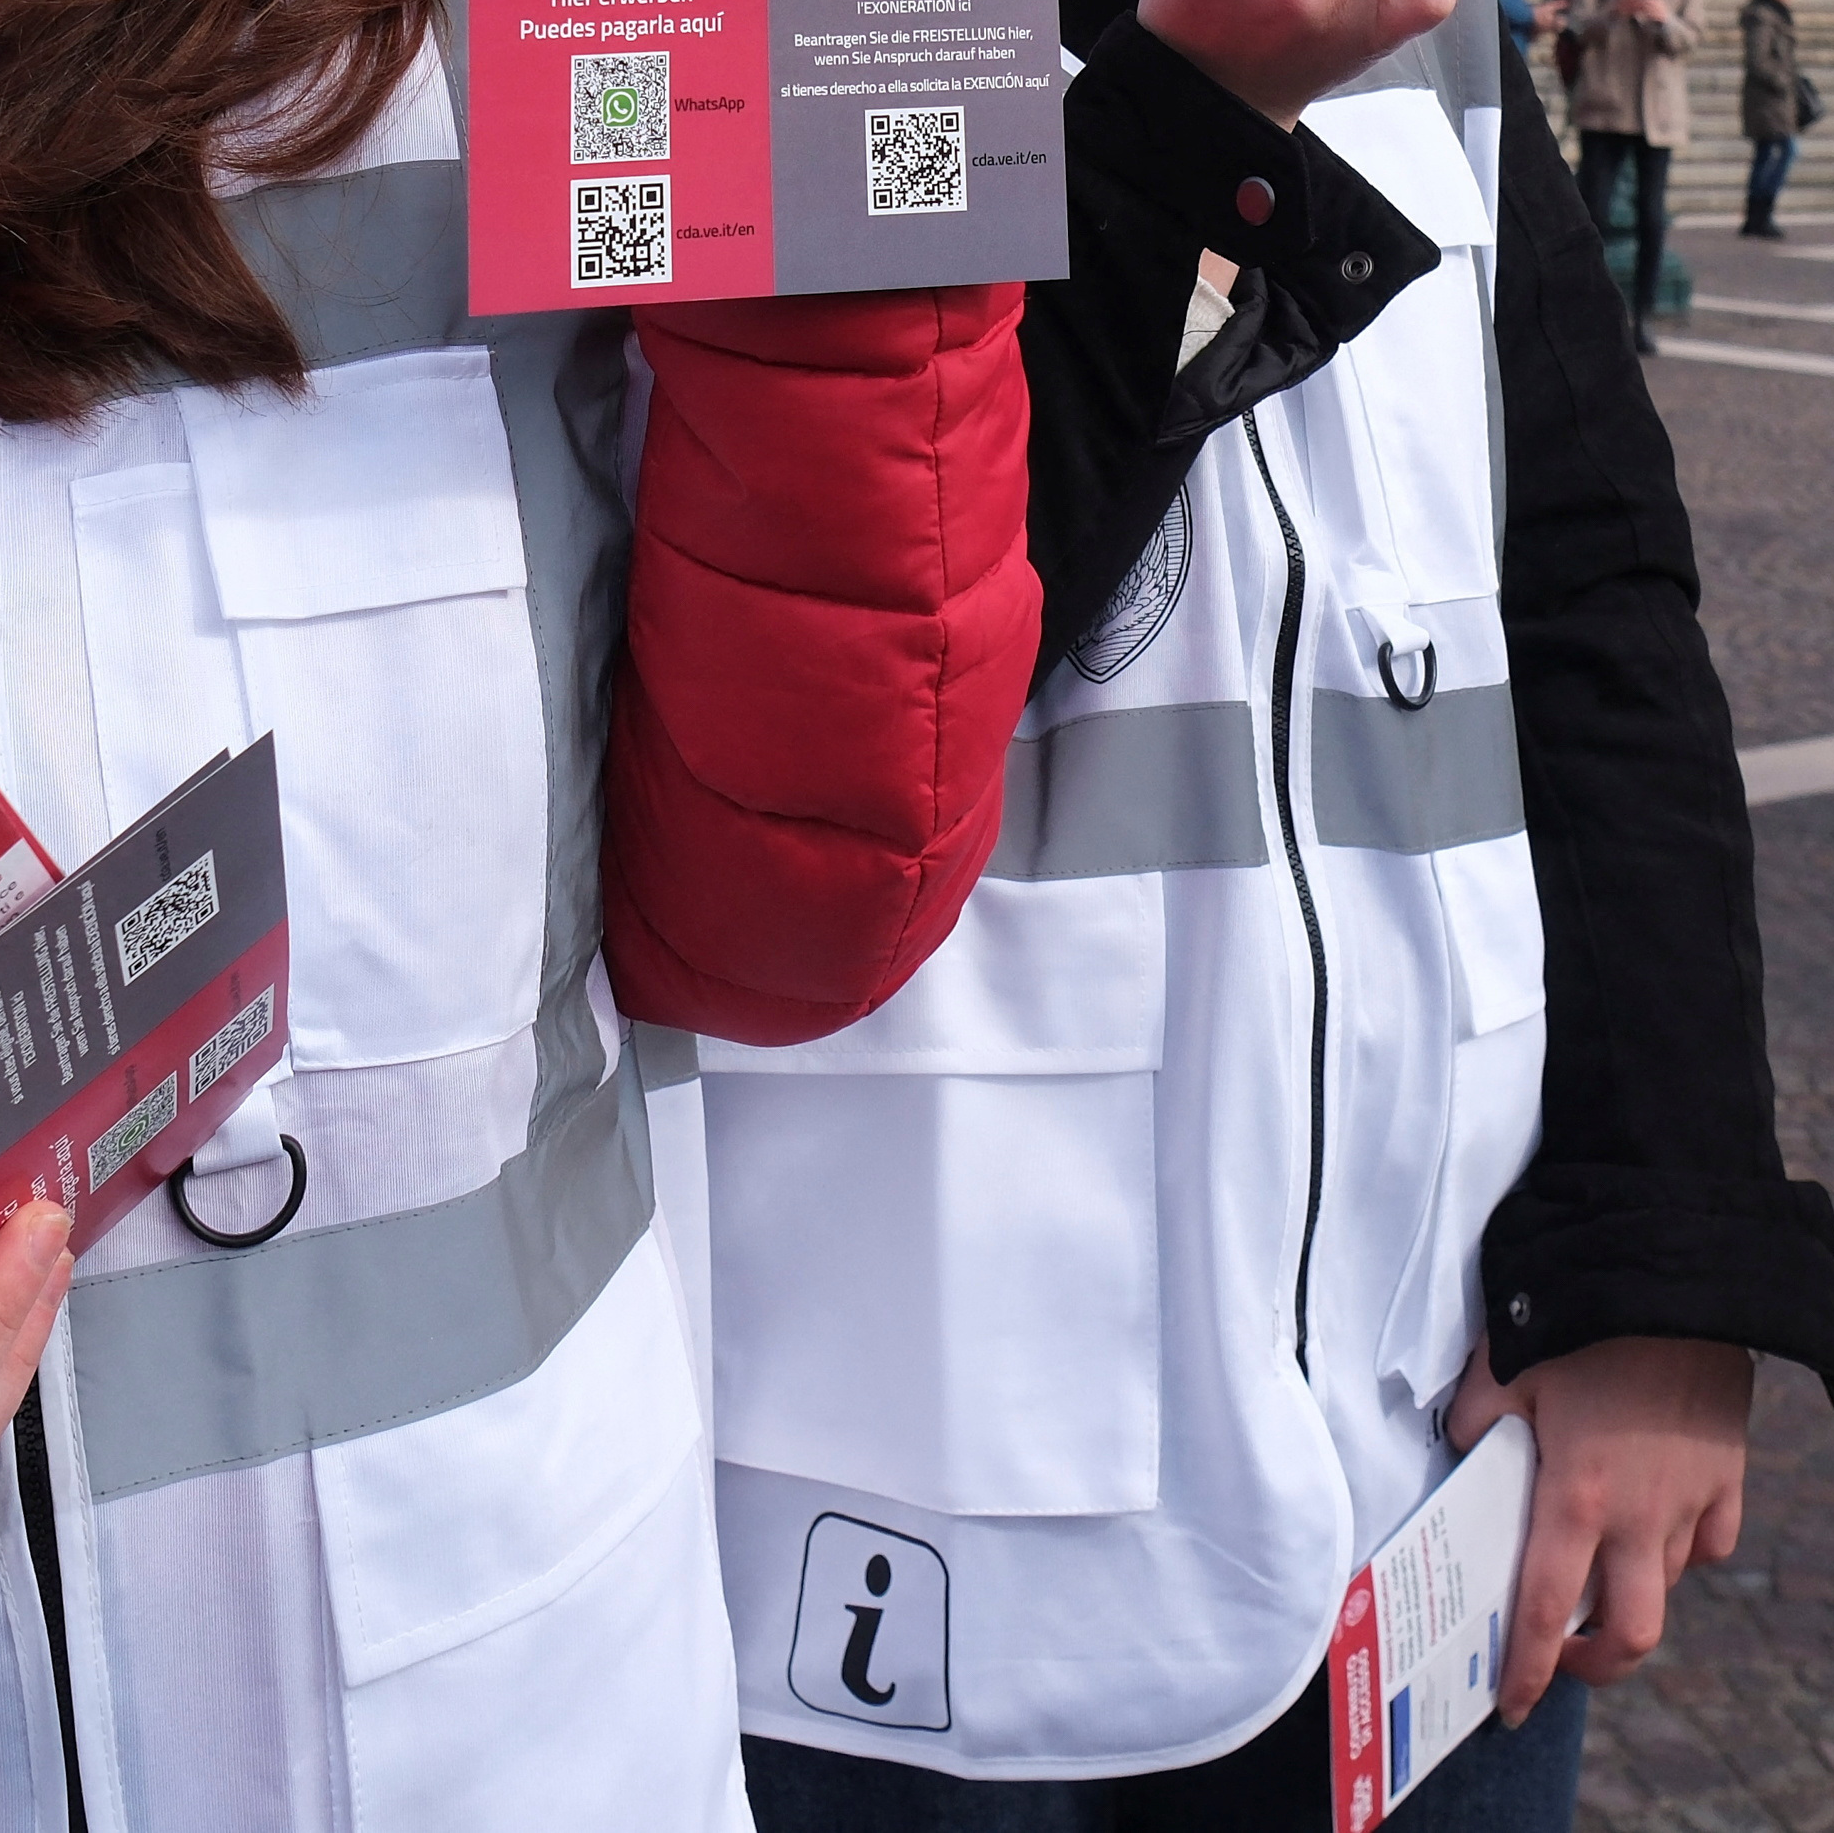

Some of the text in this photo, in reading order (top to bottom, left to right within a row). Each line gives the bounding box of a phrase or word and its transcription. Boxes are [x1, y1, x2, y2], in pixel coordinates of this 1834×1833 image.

[520, 11, 724, 42] Puedes pagarla aquí
[794, 26, 1033, 49] Beantragen Sie die FREISTELLUNG hier,
[814, 46, 1015, 66] wenn Sie Anspruch darauf haben
[780, 73, 1050, 97] si tienes derecho a ella solicita la EXENCIÓN aquí
[674, 96, 745, 113] WhatsApp
[972, 151, 1046, 167] cda.ve.it/en
[676, 222, 755, 239] cda.ve.it/en
[14, 889, 26, 902] e
[48, 1134, 74, 1166] aquí
[56, 1160, 80, 1212] pagarla
